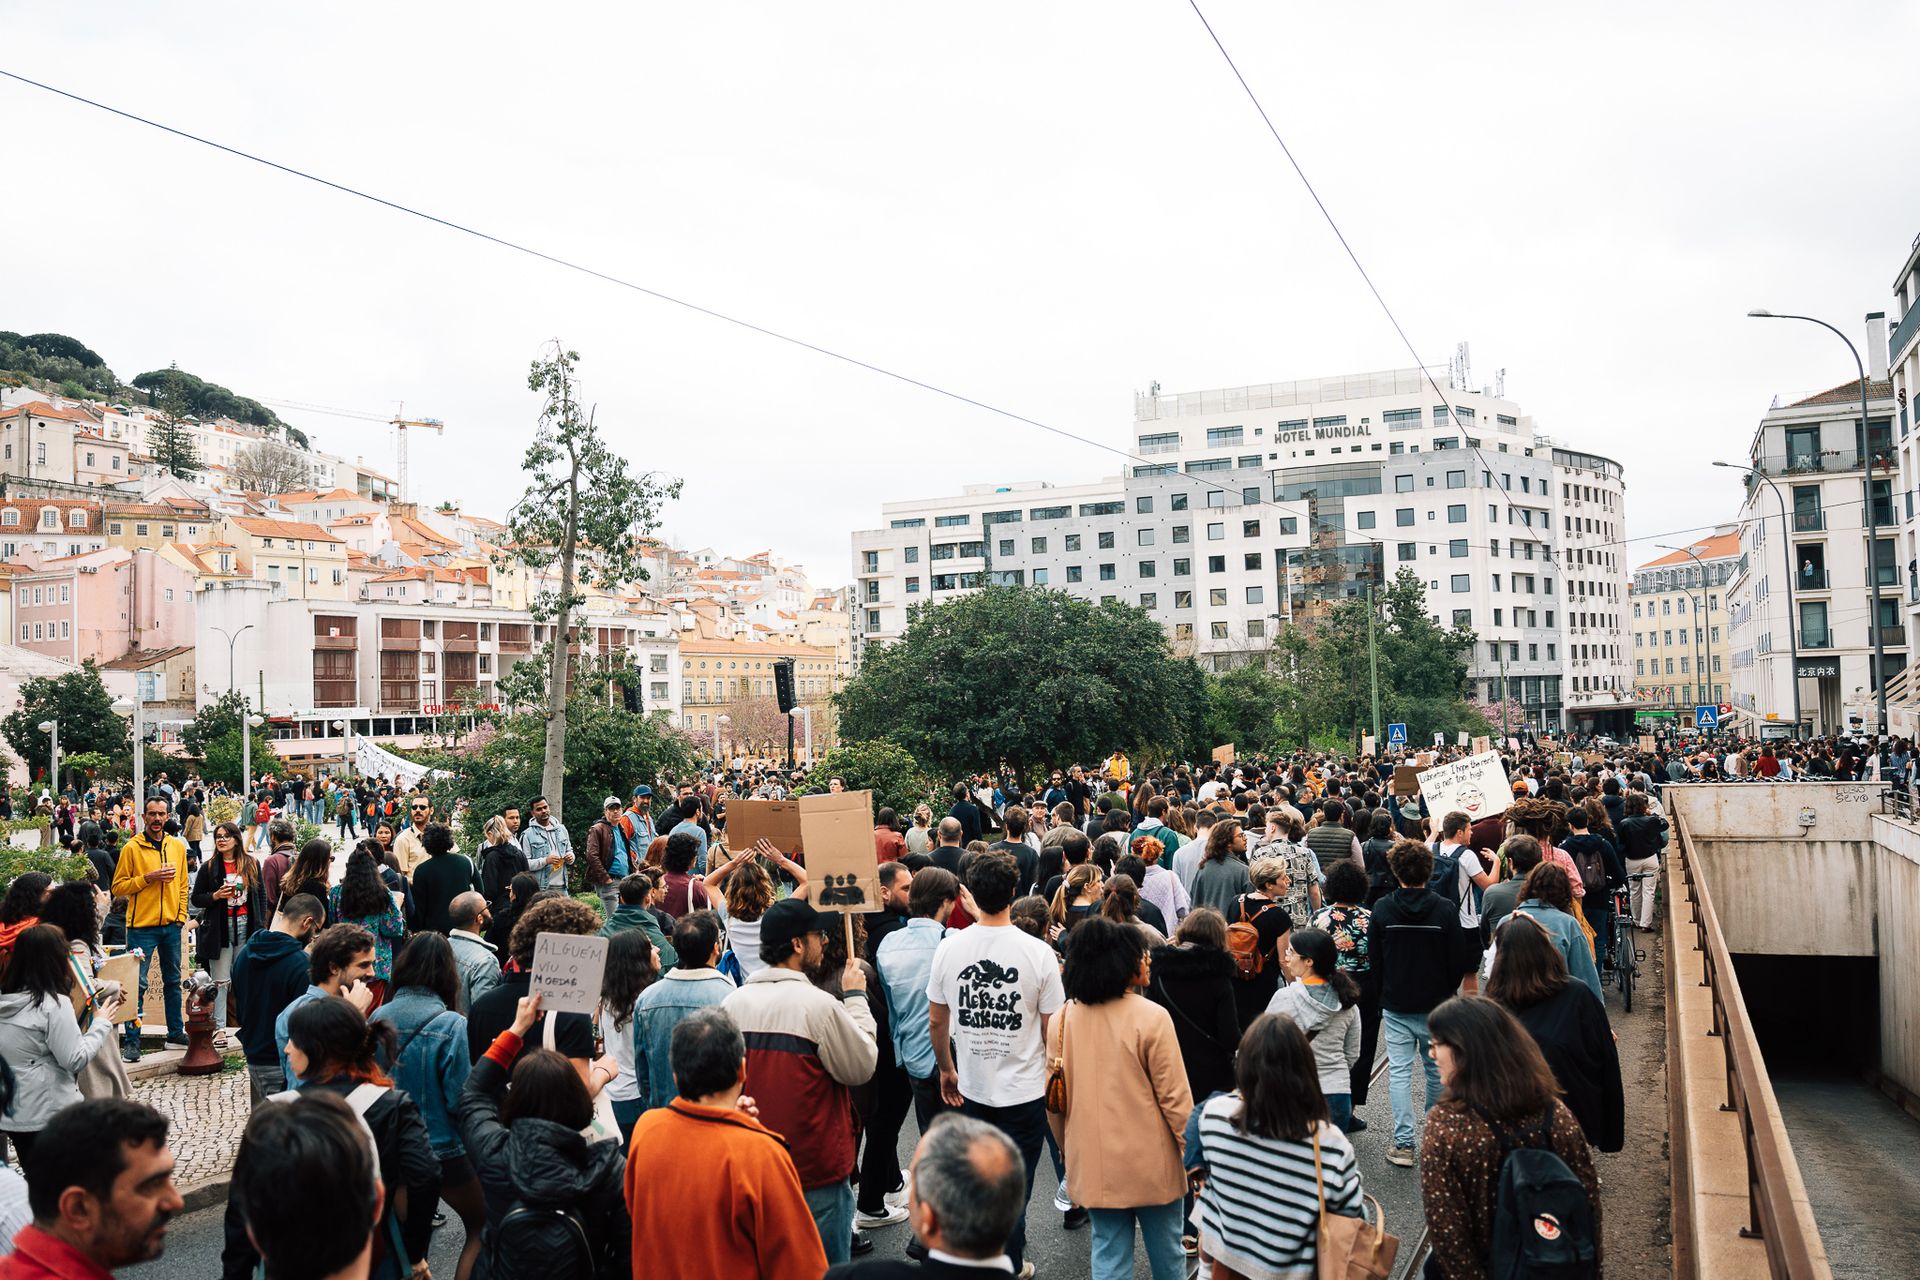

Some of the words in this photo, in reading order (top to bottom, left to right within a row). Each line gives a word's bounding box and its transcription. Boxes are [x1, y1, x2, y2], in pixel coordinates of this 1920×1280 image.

[1274, 430, 1311, 444] HOTEL
[1315, 425, 1372, 440] MUNDIAL
[851, 635, 859, 677] MUNDI
[1797, 666, 1836, 677] 北京内衣
[1456, 763, 1469, 774] hope
[1470, 760, 1480, 769] the
[1434, 782, 1440, 790] is
[1442, 777, 1453, 787] not
[1455, 774, 1467, 783] too
[1469, 768, 1484, 780] high
[538, 938, 602, 961] ALGUÉM
[569, 964, 578, 974] O
